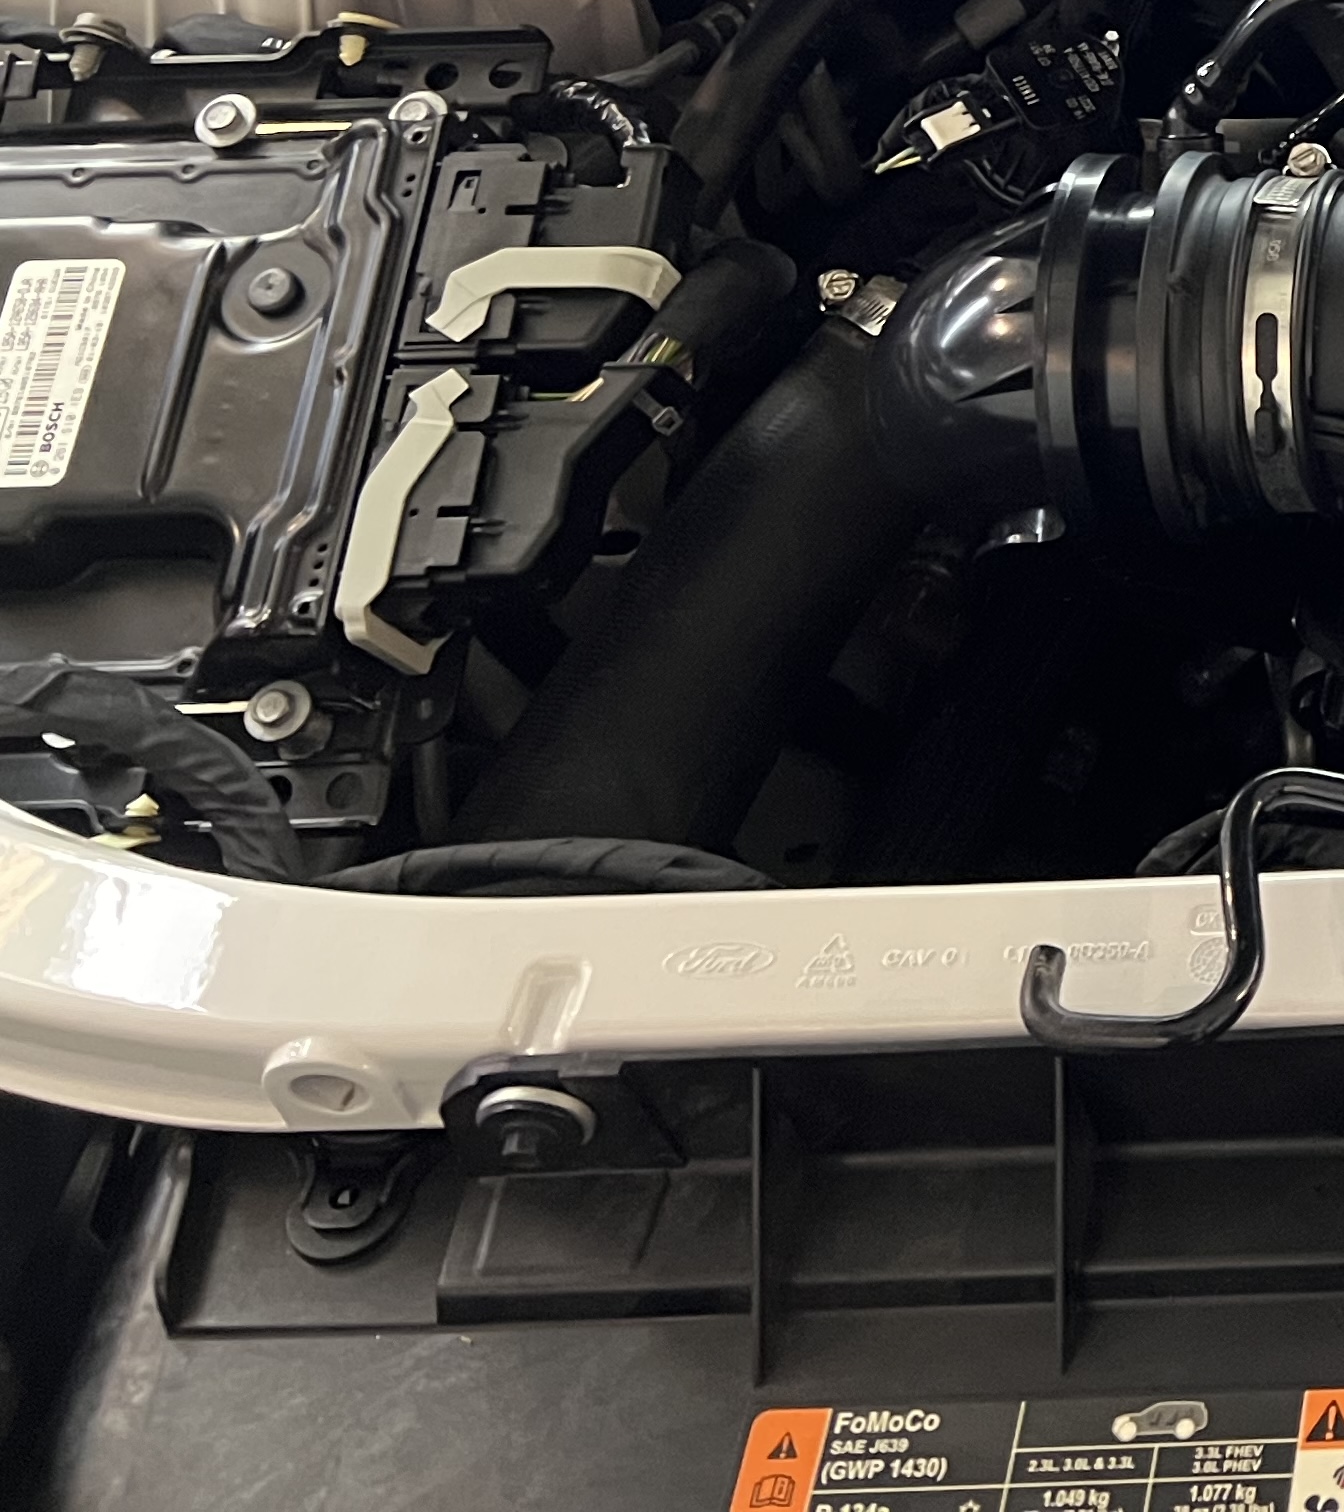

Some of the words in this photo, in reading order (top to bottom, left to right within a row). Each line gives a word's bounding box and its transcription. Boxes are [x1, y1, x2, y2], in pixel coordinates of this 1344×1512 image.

[39, 402, 65, 452] BOSCH
[53, 442, 69, 461] 261
[678, 944, 764, 977] Ford
[881, 948, 937, 968] CAV
[833, 1409, 941, 1434] FoMoCo
[829, 1439, 866, 1455] SAE
[867, 1438, 910, 1454] J639
[1224, 1444, 1264, 1458] FHEV
[820, 1458, 886, 1485] (GWP
[889, 1457, 949, 1482] 1430)
[1093, 1457, 1106, 1471] &
[1222, 1459, 1262, 1473] PHEV
[1043, 1488, 1086, 1507] 1.049
[1087, 1488, 1111, 1509] kg
[1190, 1484, 1232, 1502] 1.077
[1234, 1483, 1258, 1504] kg
